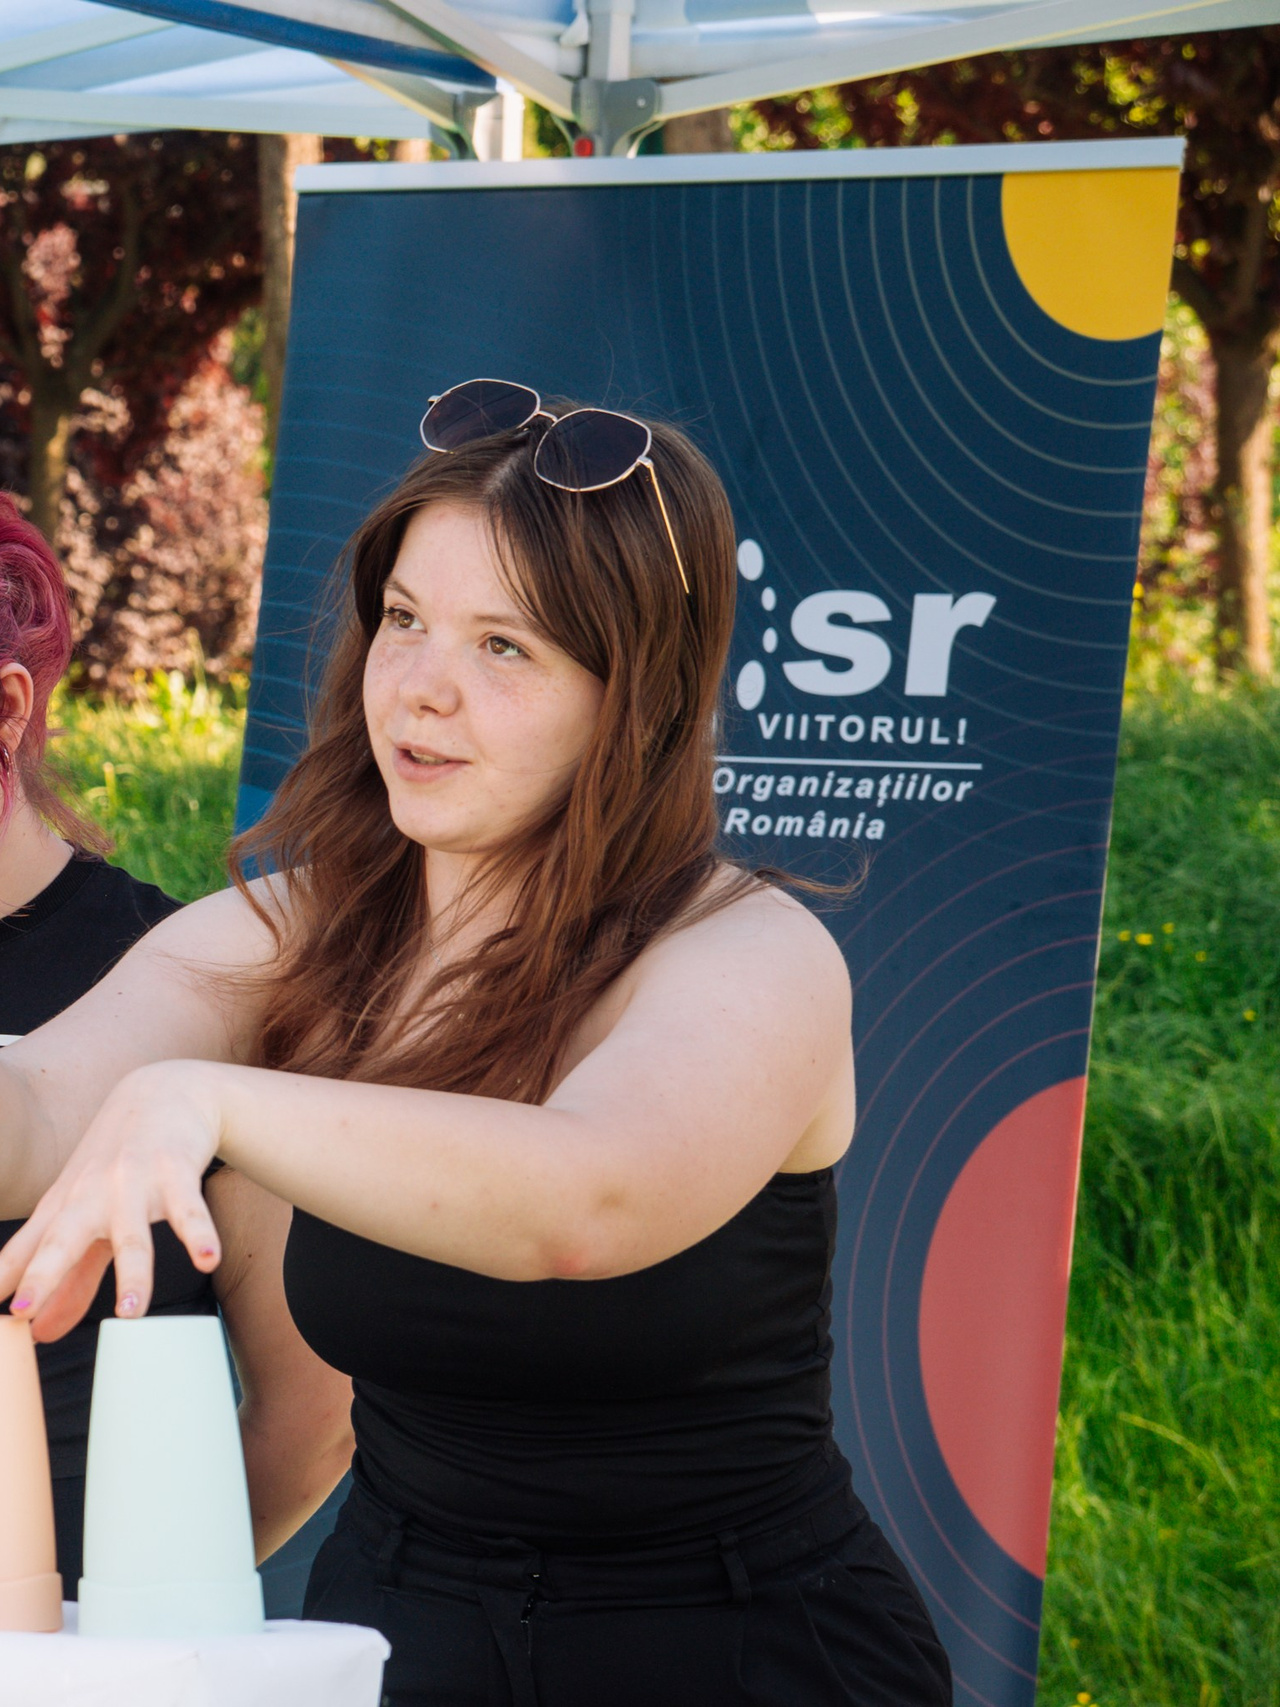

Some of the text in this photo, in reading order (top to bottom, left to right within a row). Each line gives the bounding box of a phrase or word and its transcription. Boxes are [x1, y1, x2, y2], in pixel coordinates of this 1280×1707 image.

[757, 712, 968, 745] VIITORUL!
[713, 766, 973, 808] Organizațiilor
[724, 807, 886, 840] România
